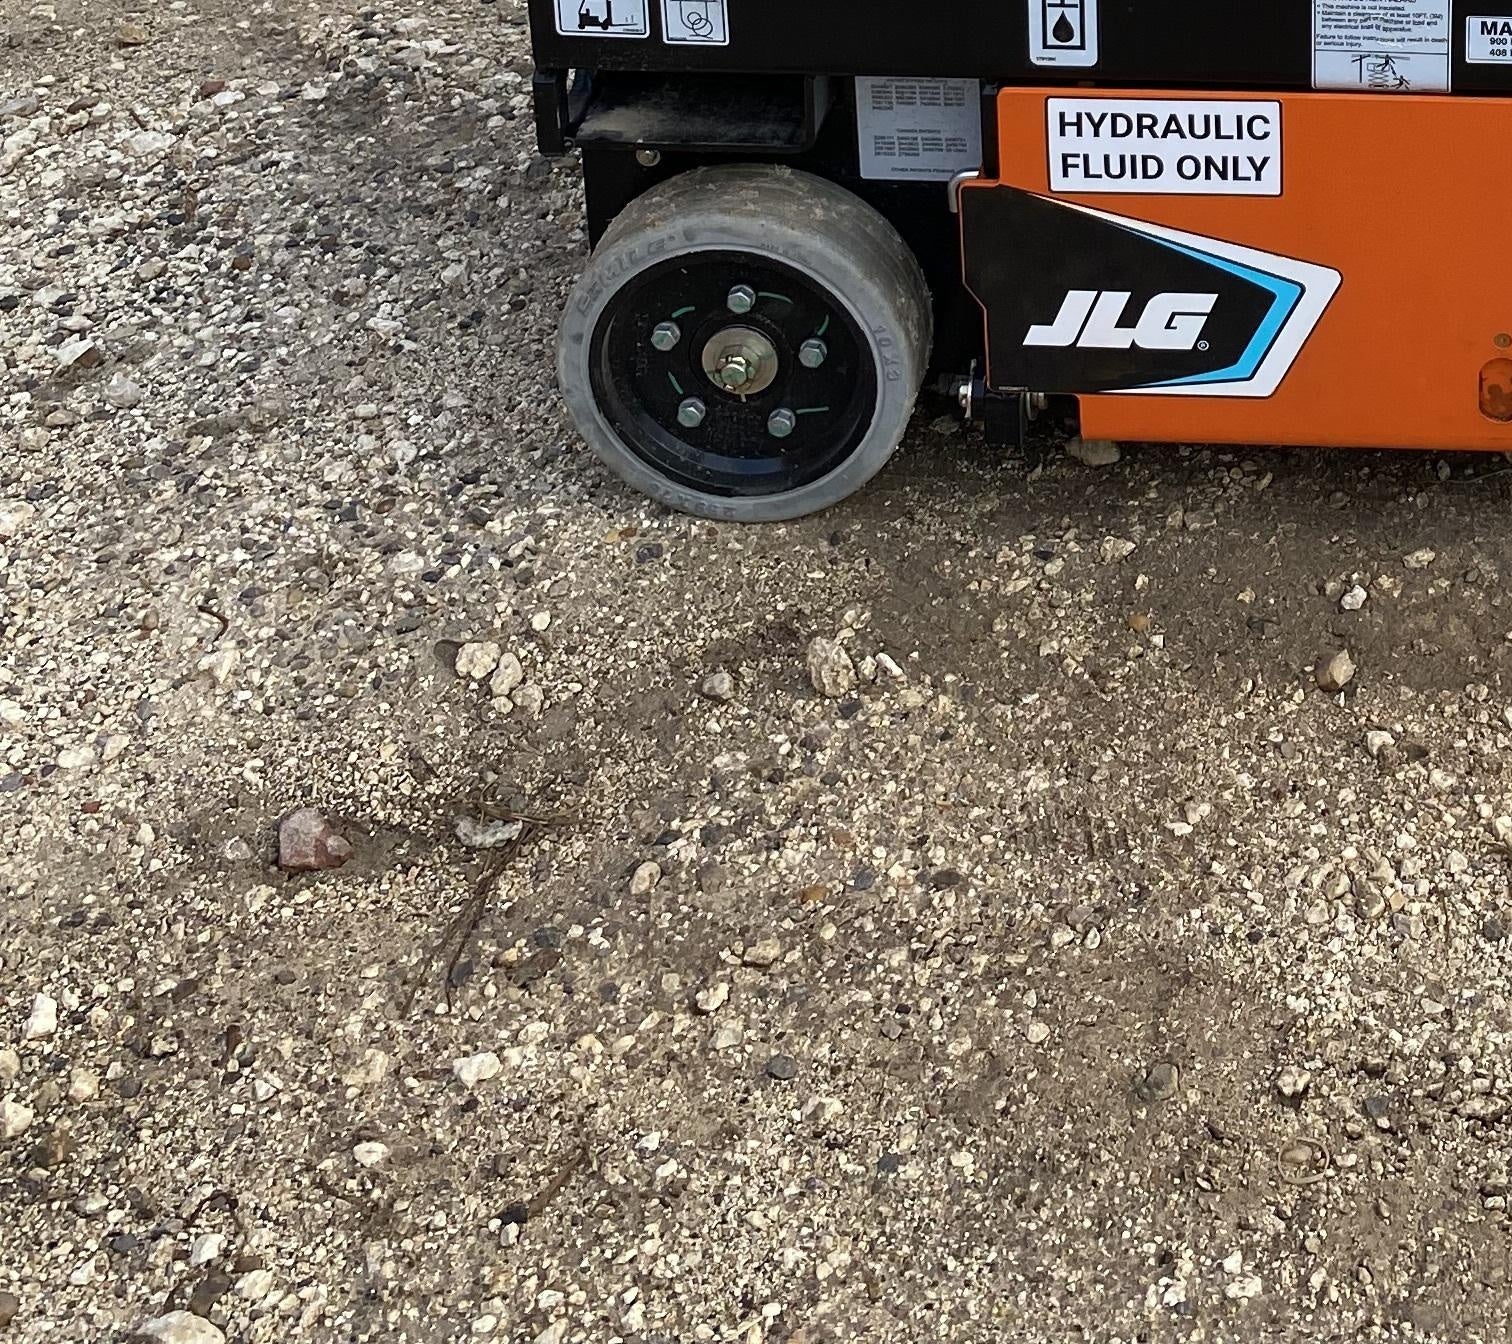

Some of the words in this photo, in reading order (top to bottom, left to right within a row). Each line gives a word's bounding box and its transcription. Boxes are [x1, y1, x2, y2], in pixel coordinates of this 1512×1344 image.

[1489, 37, 1508, 46] 900
[1058, 111, 1271, 141] HYDRAULIC
[1061, 153, 1165, 180] FLUID
[1176, 154, 1271, 182] ONLY
[1022, 289, 1219, 350] JLG
